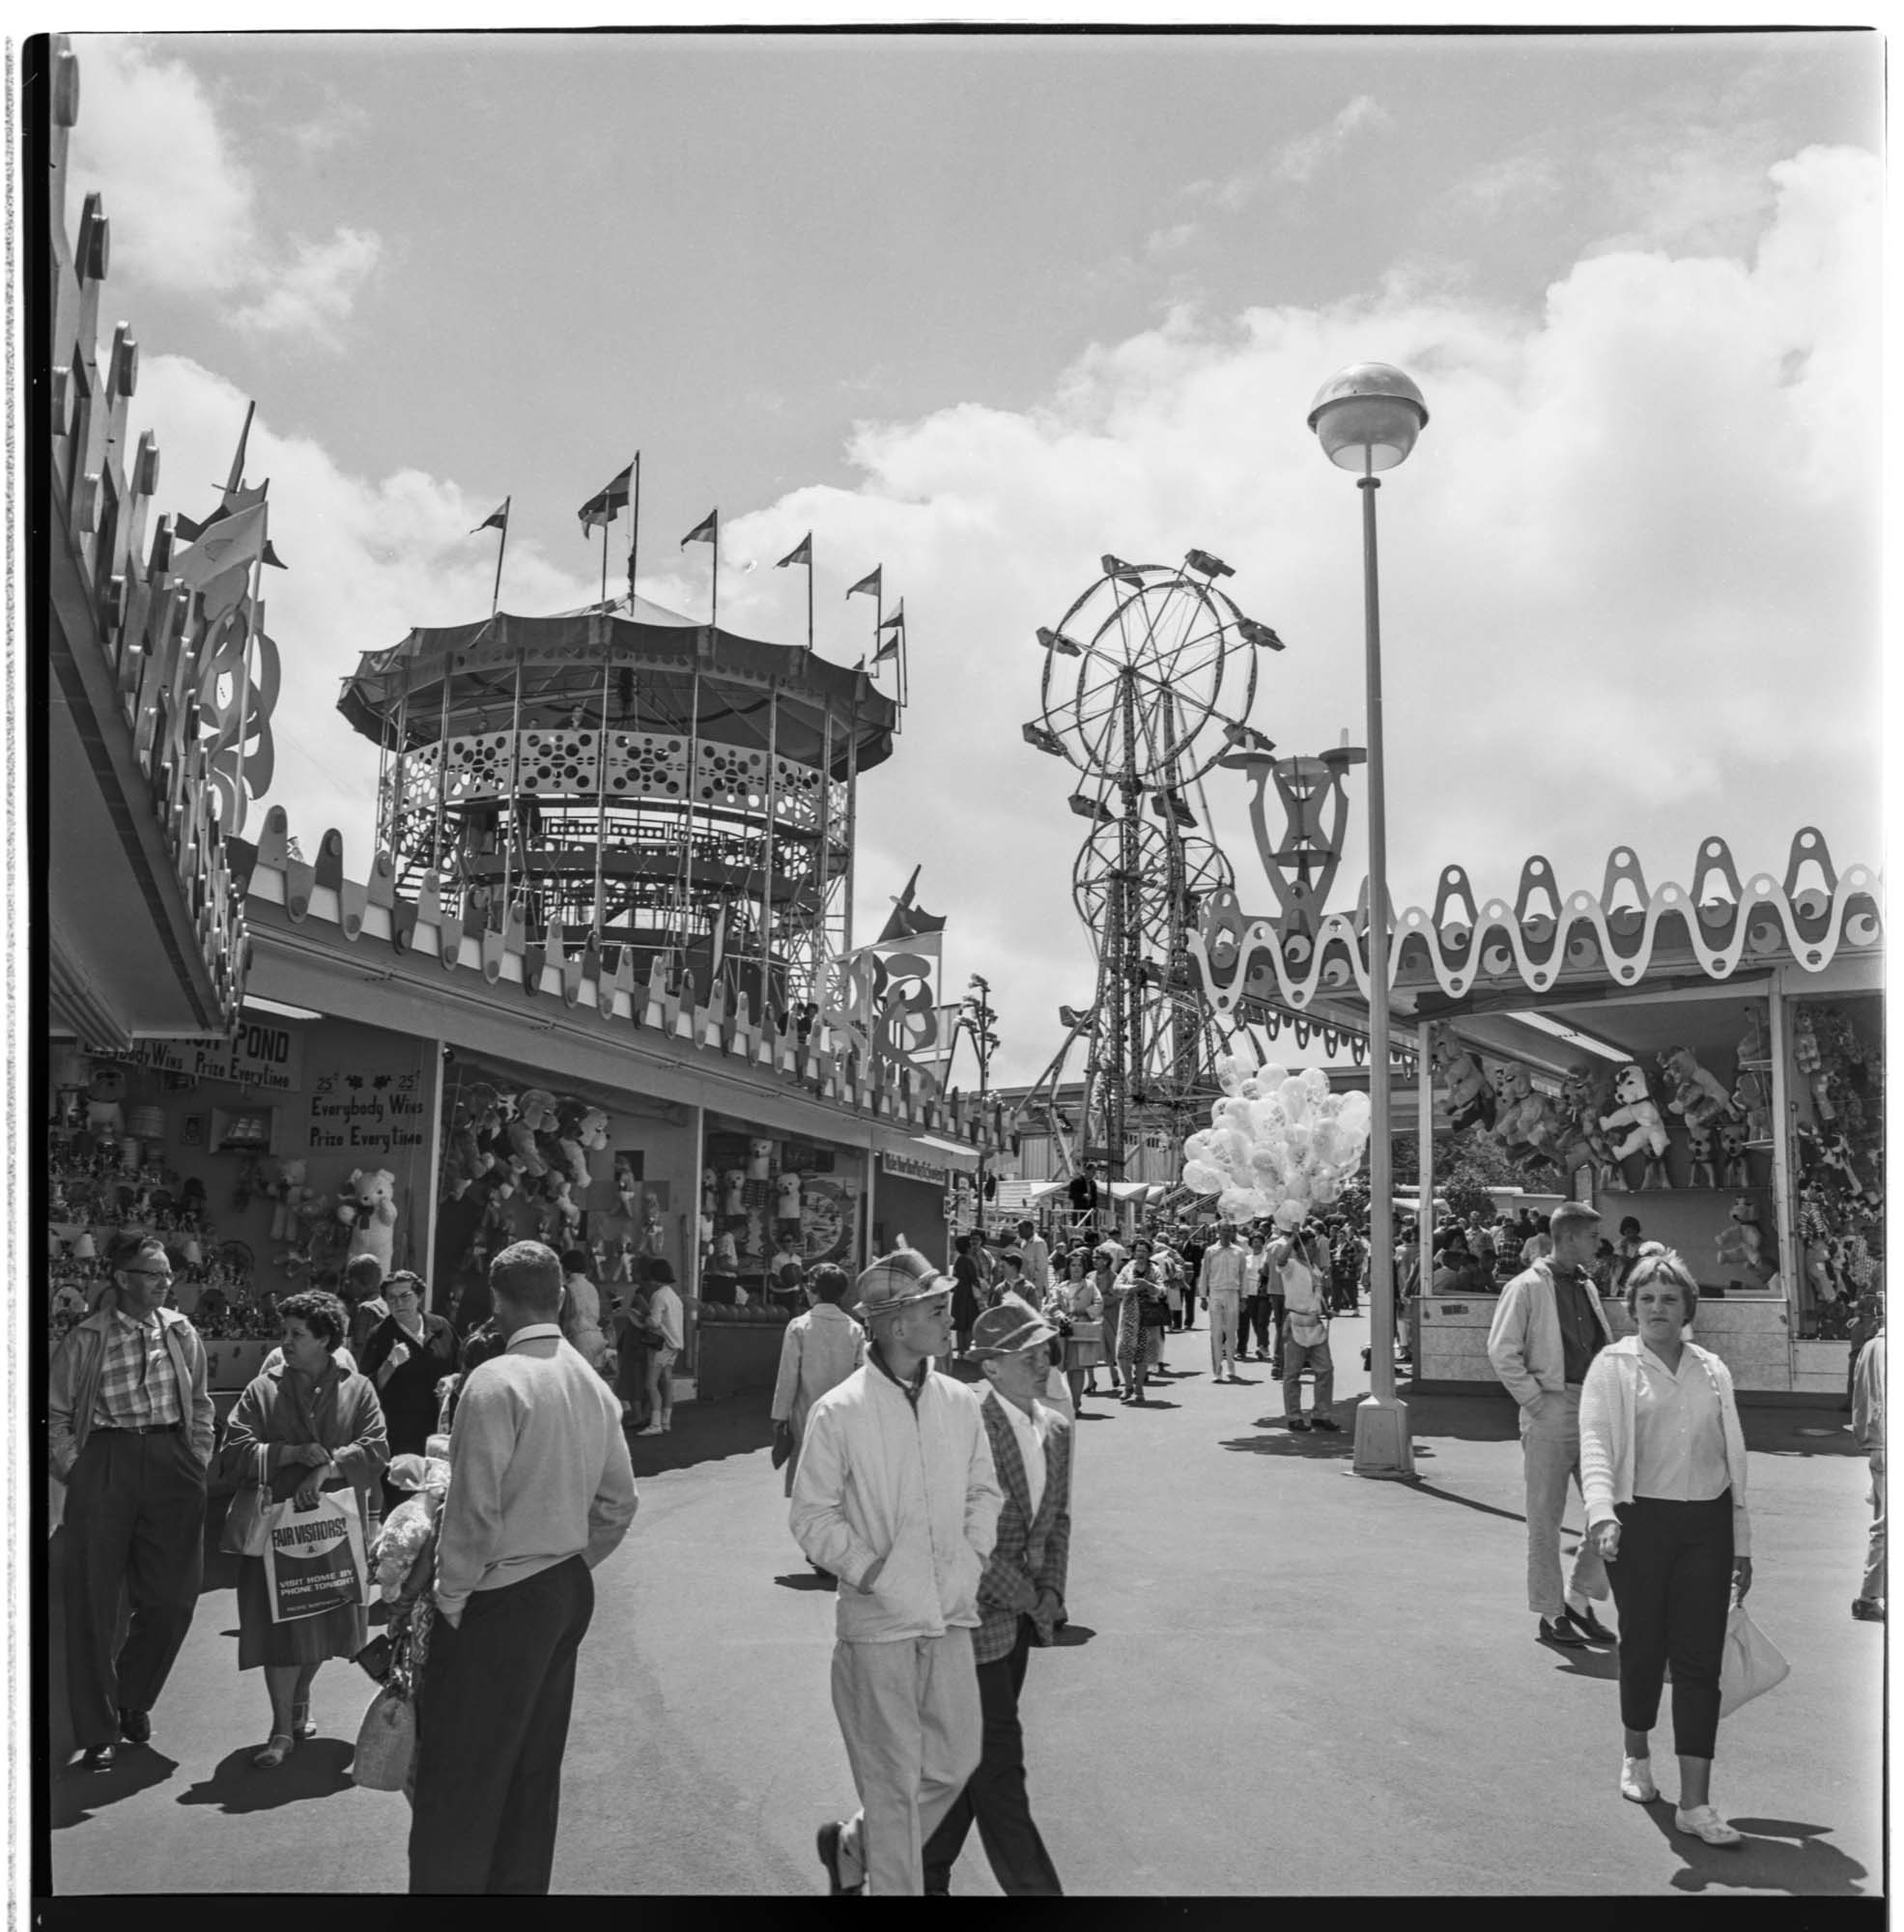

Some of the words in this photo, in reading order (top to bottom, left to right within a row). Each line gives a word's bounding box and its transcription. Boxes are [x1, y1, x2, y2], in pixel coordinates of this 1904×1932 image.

[232, 1023, 289, 1064] POND
[153, 1042, 183, 1069] Wins
[195, 1050, 225, 1077] Prize
[311, 1094, 384, 1123] Everybody
[389, 1094, 423, 1115] Wins
[310, 1126, 344, 1147] Prize
[271, 1526, 294, 1548] FAIR
[295, 1517, 348, 1545] VISITORS!
[280, 1585, 311, 1596] PHONE
[314, 1577, 354, 1590] TONIGHT
[306, 1573, 336, 1584] HOME
